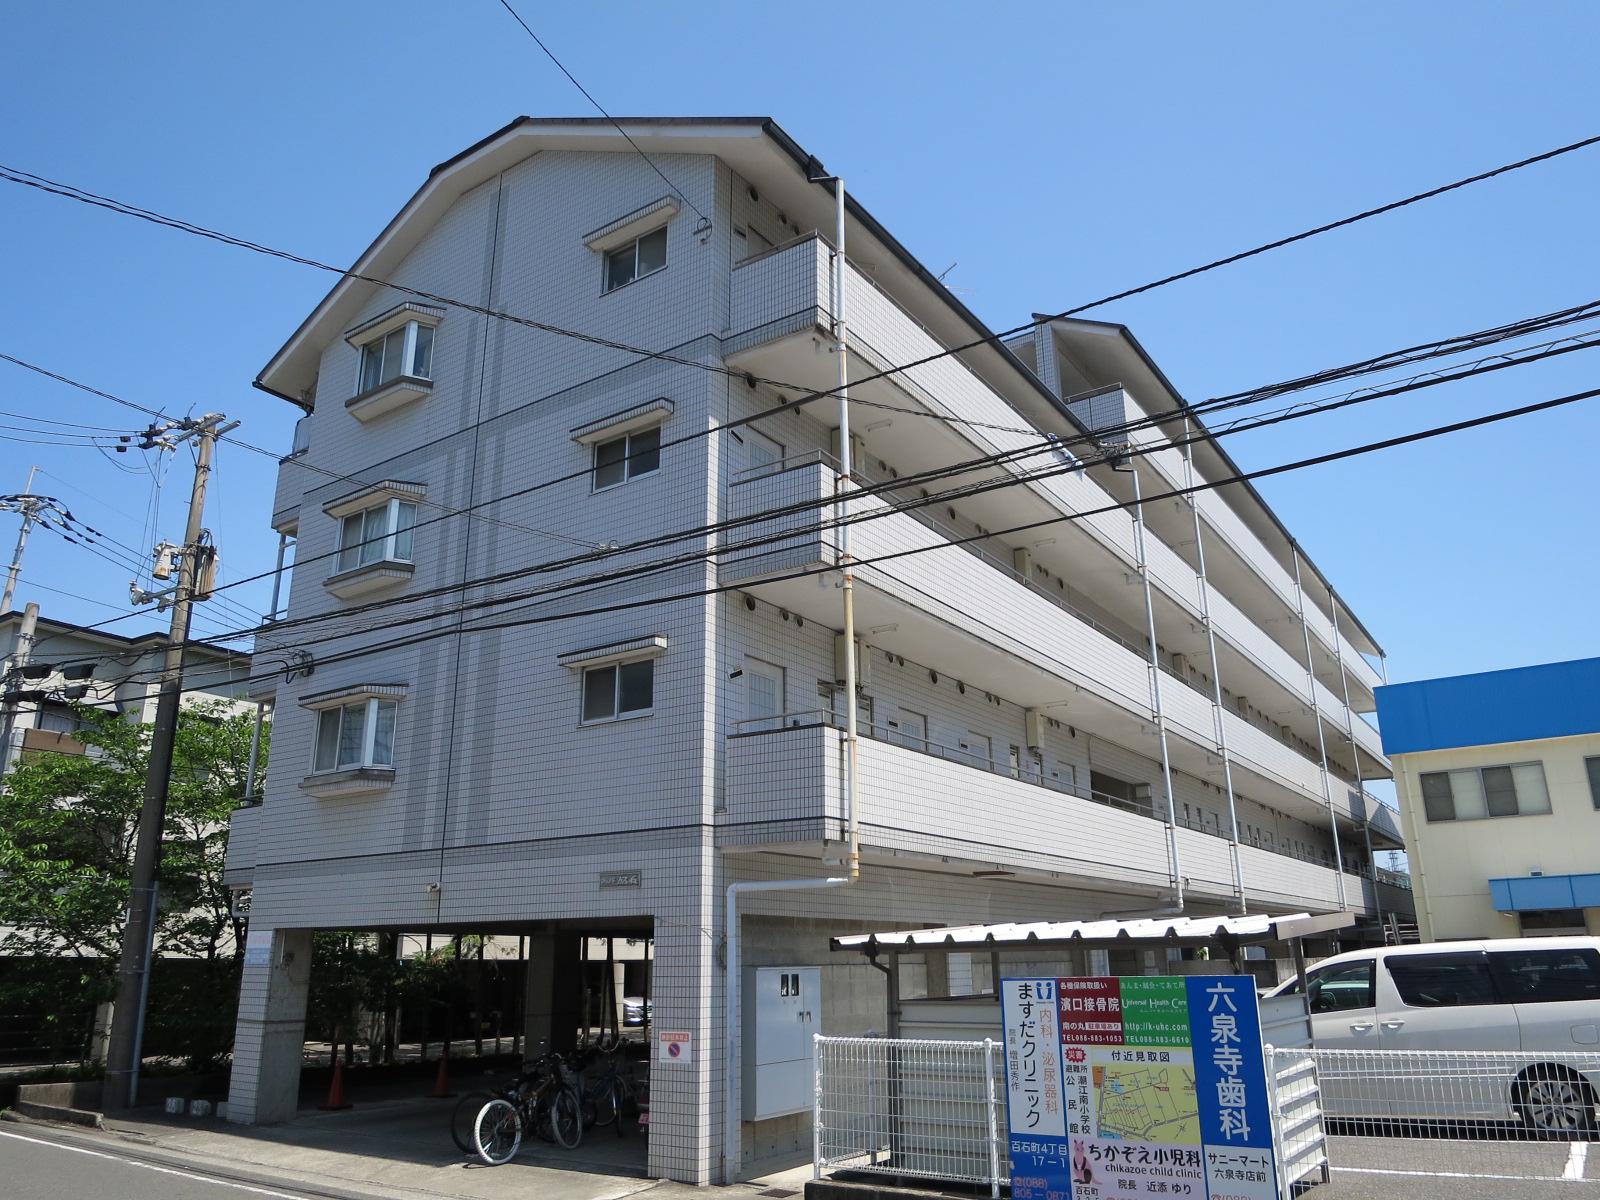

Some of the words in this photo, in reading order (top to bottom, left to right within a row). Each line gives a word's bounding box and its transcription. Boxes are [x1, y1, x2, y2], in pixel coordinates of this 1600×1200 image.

[1018, 983, 1040, 1128] ますだクリニック
[1111, 1050, 1170, 1062] 付近見取図
[1206, 982, 1250, 1141] 六泉寺歯科
[1088, 1144, 1200, 1168] ちかぞえ小児科
[1208, 1153, 1269, 1168] サニーマート
[1105, 1163, 1147, 1174] chikazoe
[1150, 1167, 1173, 1177] child
[1176, 1169, 1202, 1179] clinic
[1214, 1168, 1266, 1182] 六泉寺店前
